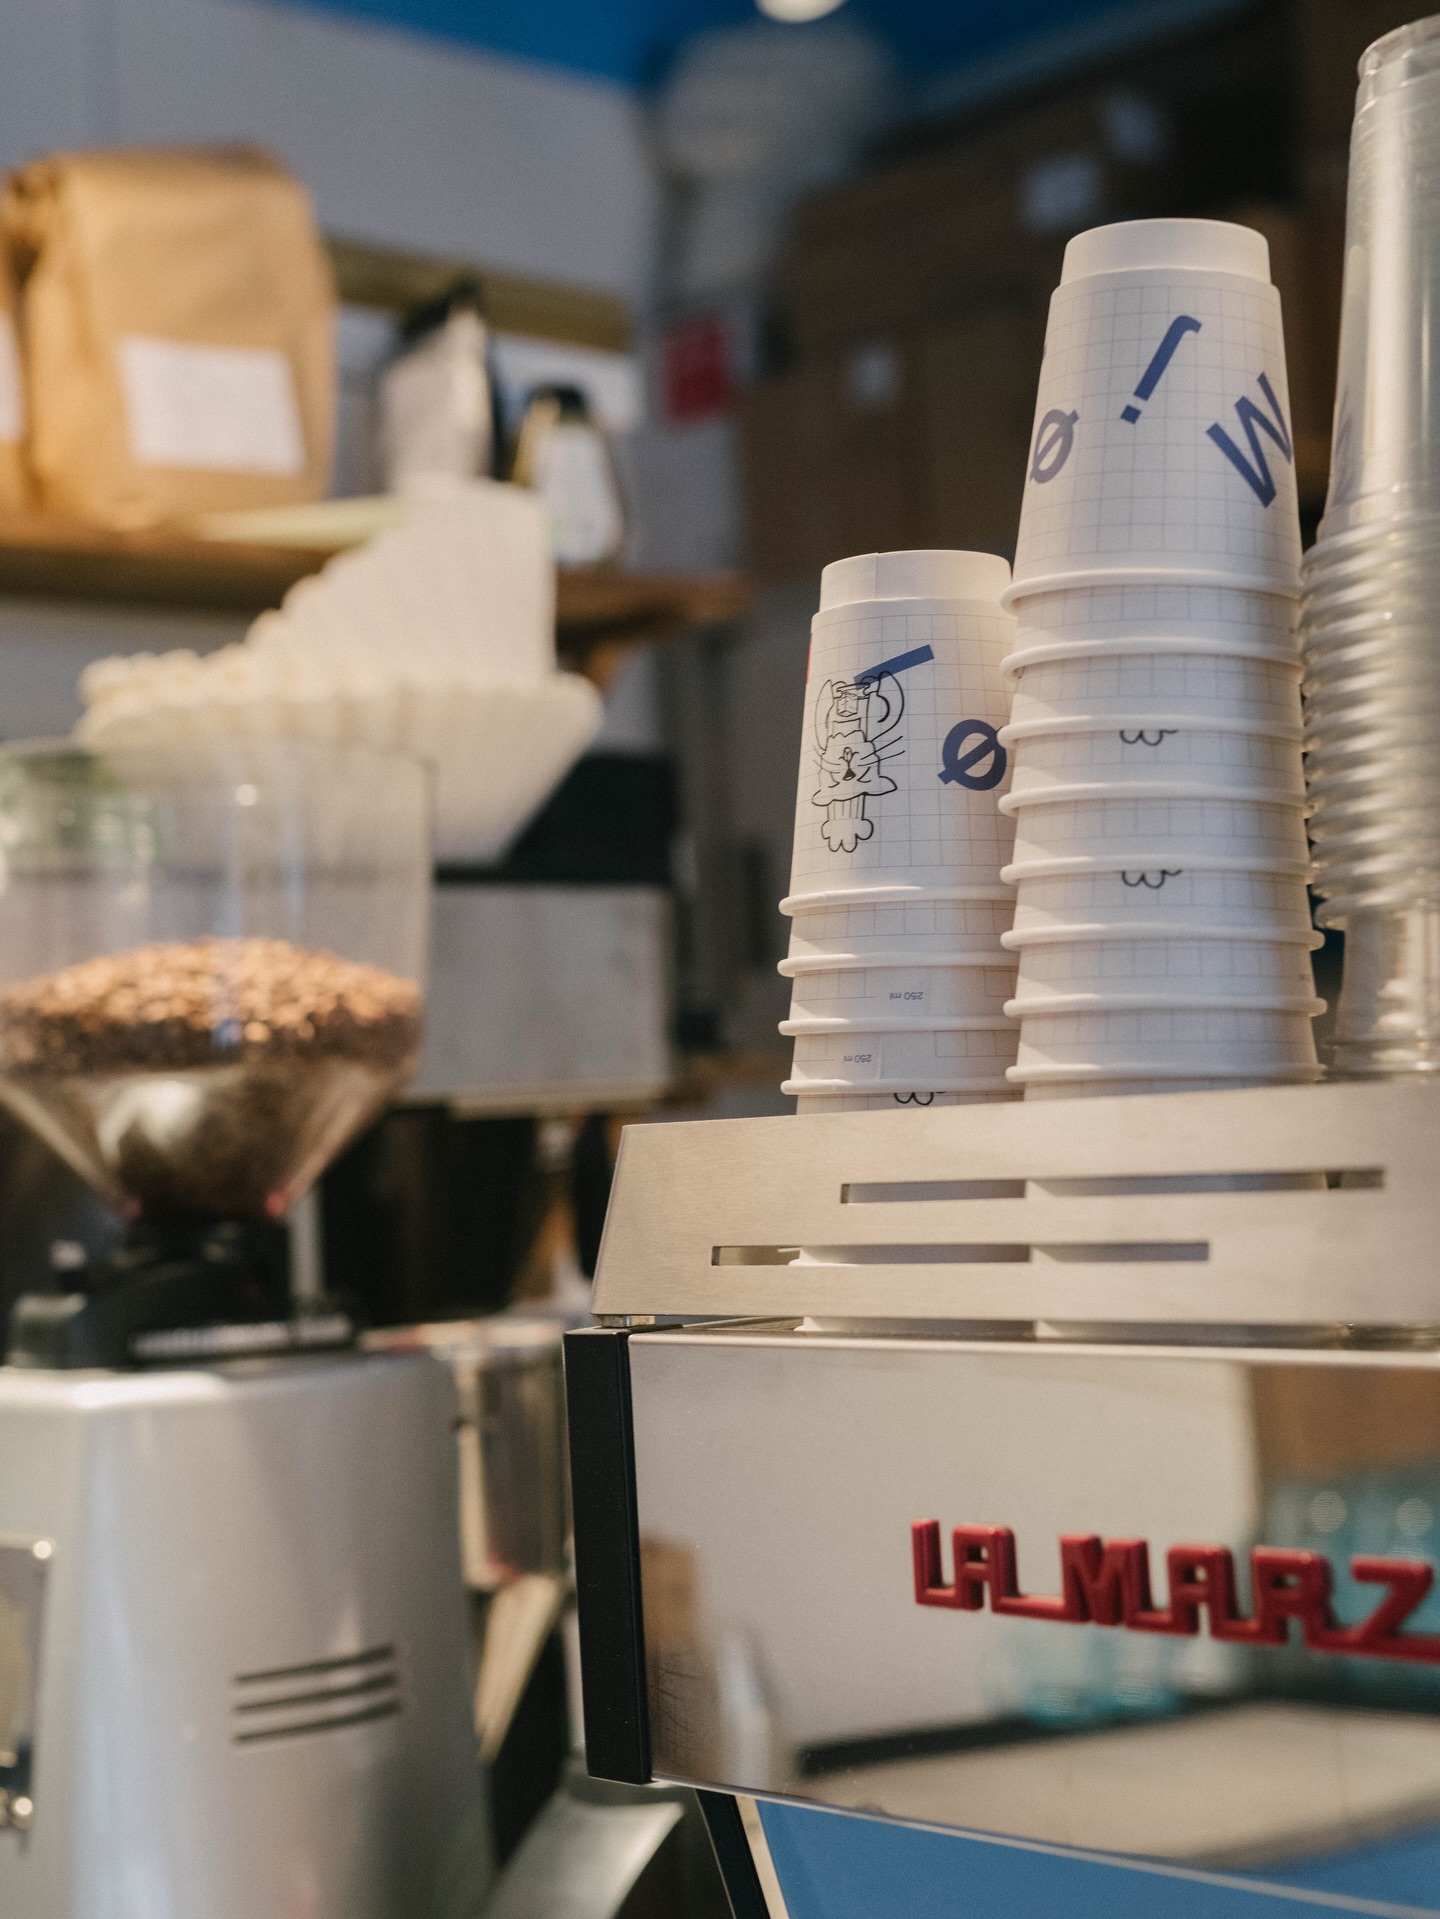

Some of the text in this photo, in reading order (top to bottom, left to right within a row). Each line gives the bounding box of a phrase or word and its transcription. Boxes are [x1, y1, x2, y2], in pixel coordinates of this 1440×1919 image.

[889, 991, 924, 1000] 250 ml
[843, 1054, 872, 1063] 250 ml
[911, 1518, 1020, 1615] LA
